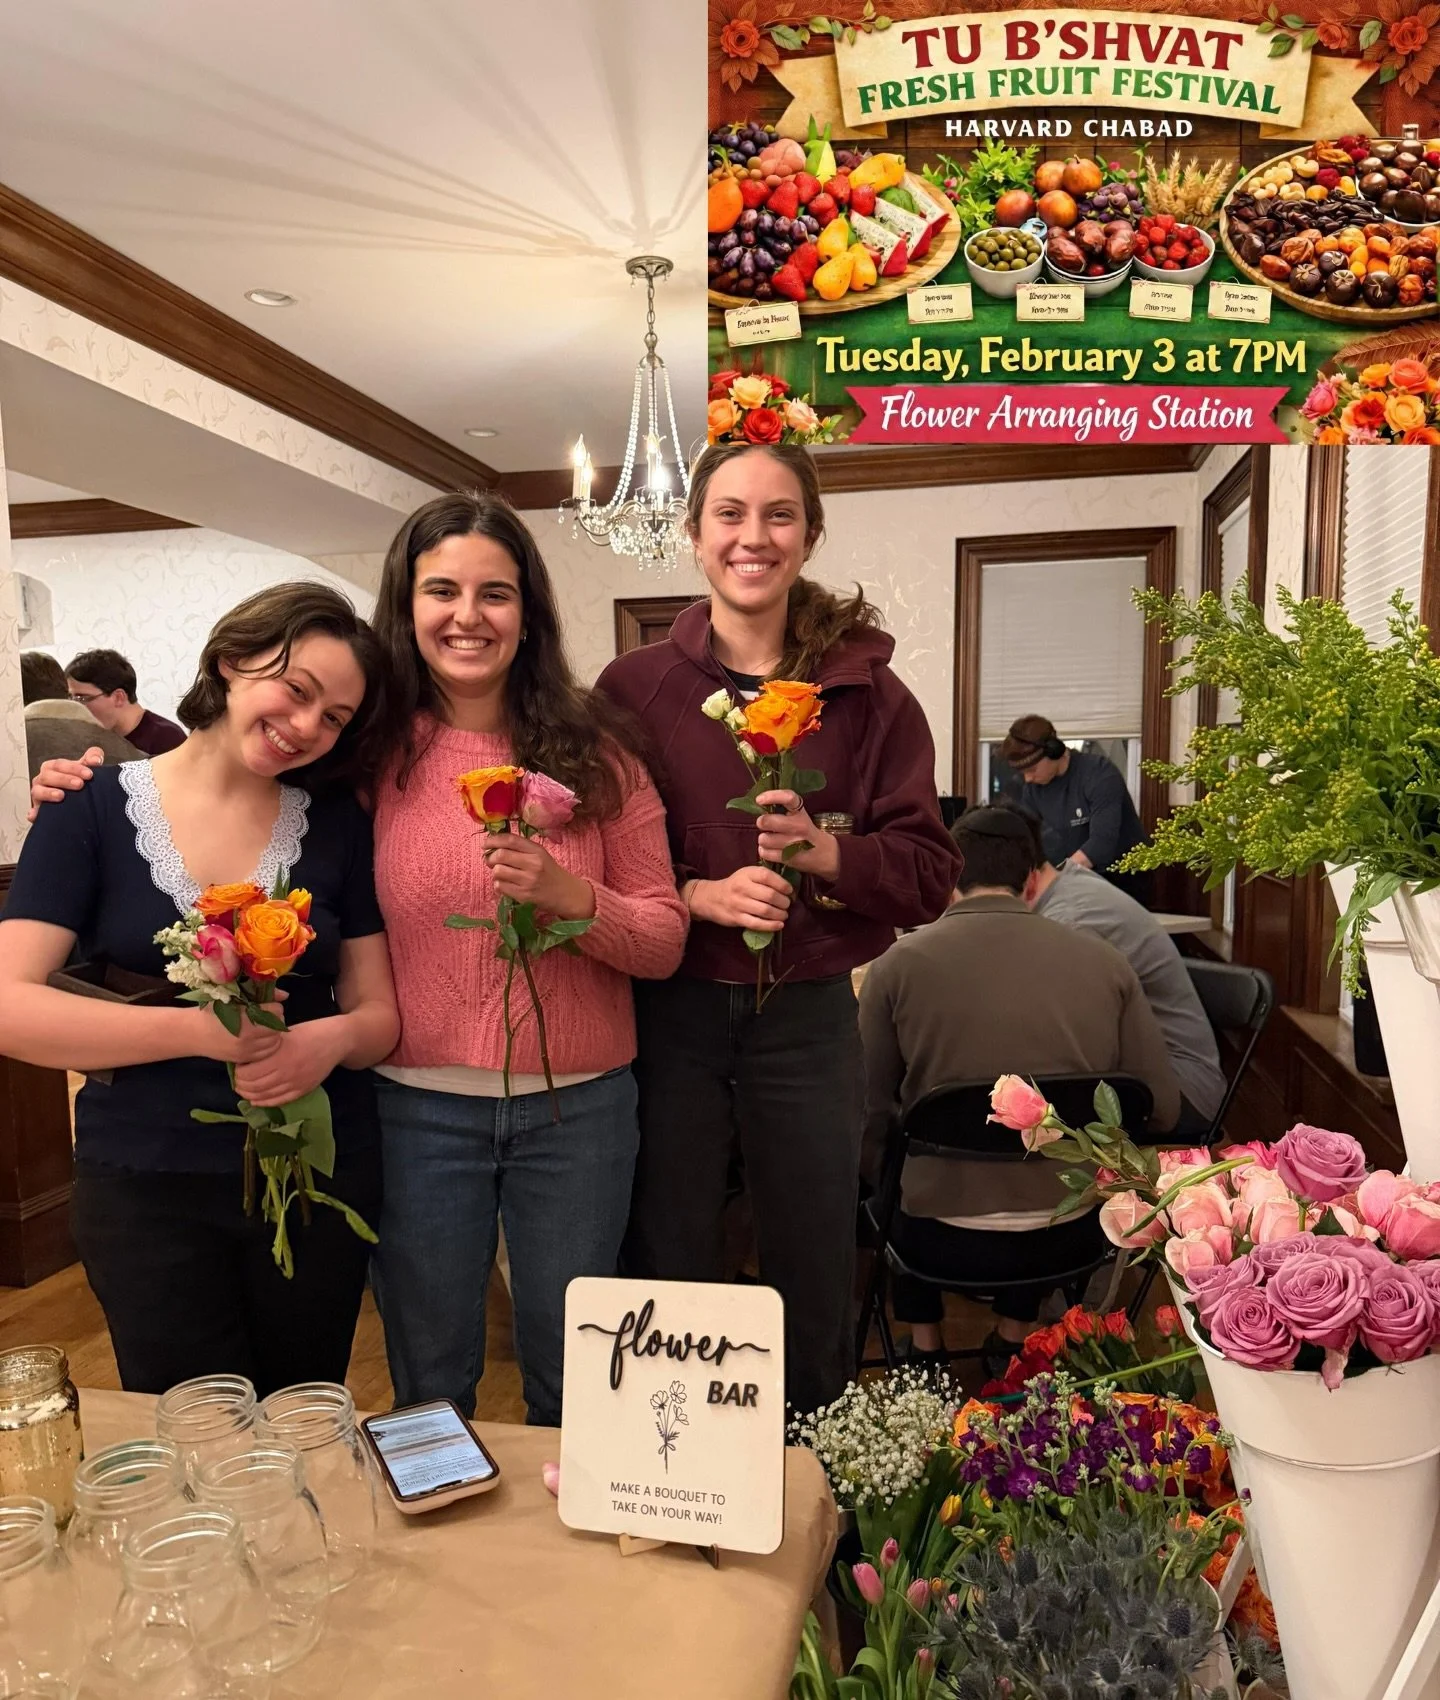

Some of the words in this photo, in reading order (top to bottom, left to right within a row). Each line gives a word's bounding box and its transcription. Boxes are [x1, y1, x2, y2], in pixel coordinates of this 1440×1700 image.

[577, 1299, 770, 1390] flower
[706, 1380, 759, 1408] BAR
[610, 1481, 641, 1495] MAKE
[643, 1485, 651, 1497] A
[655, 1486, 707, 1503] BOUQUET
[711, 1493, 726, 1506] TO
[611, 1500, 637, 1514] TAKE
[640, 1504, 658, 1516] ON
[660, 1506, 691, 1520] YOUR
[694, 1511, 722, 1525] WAY!
